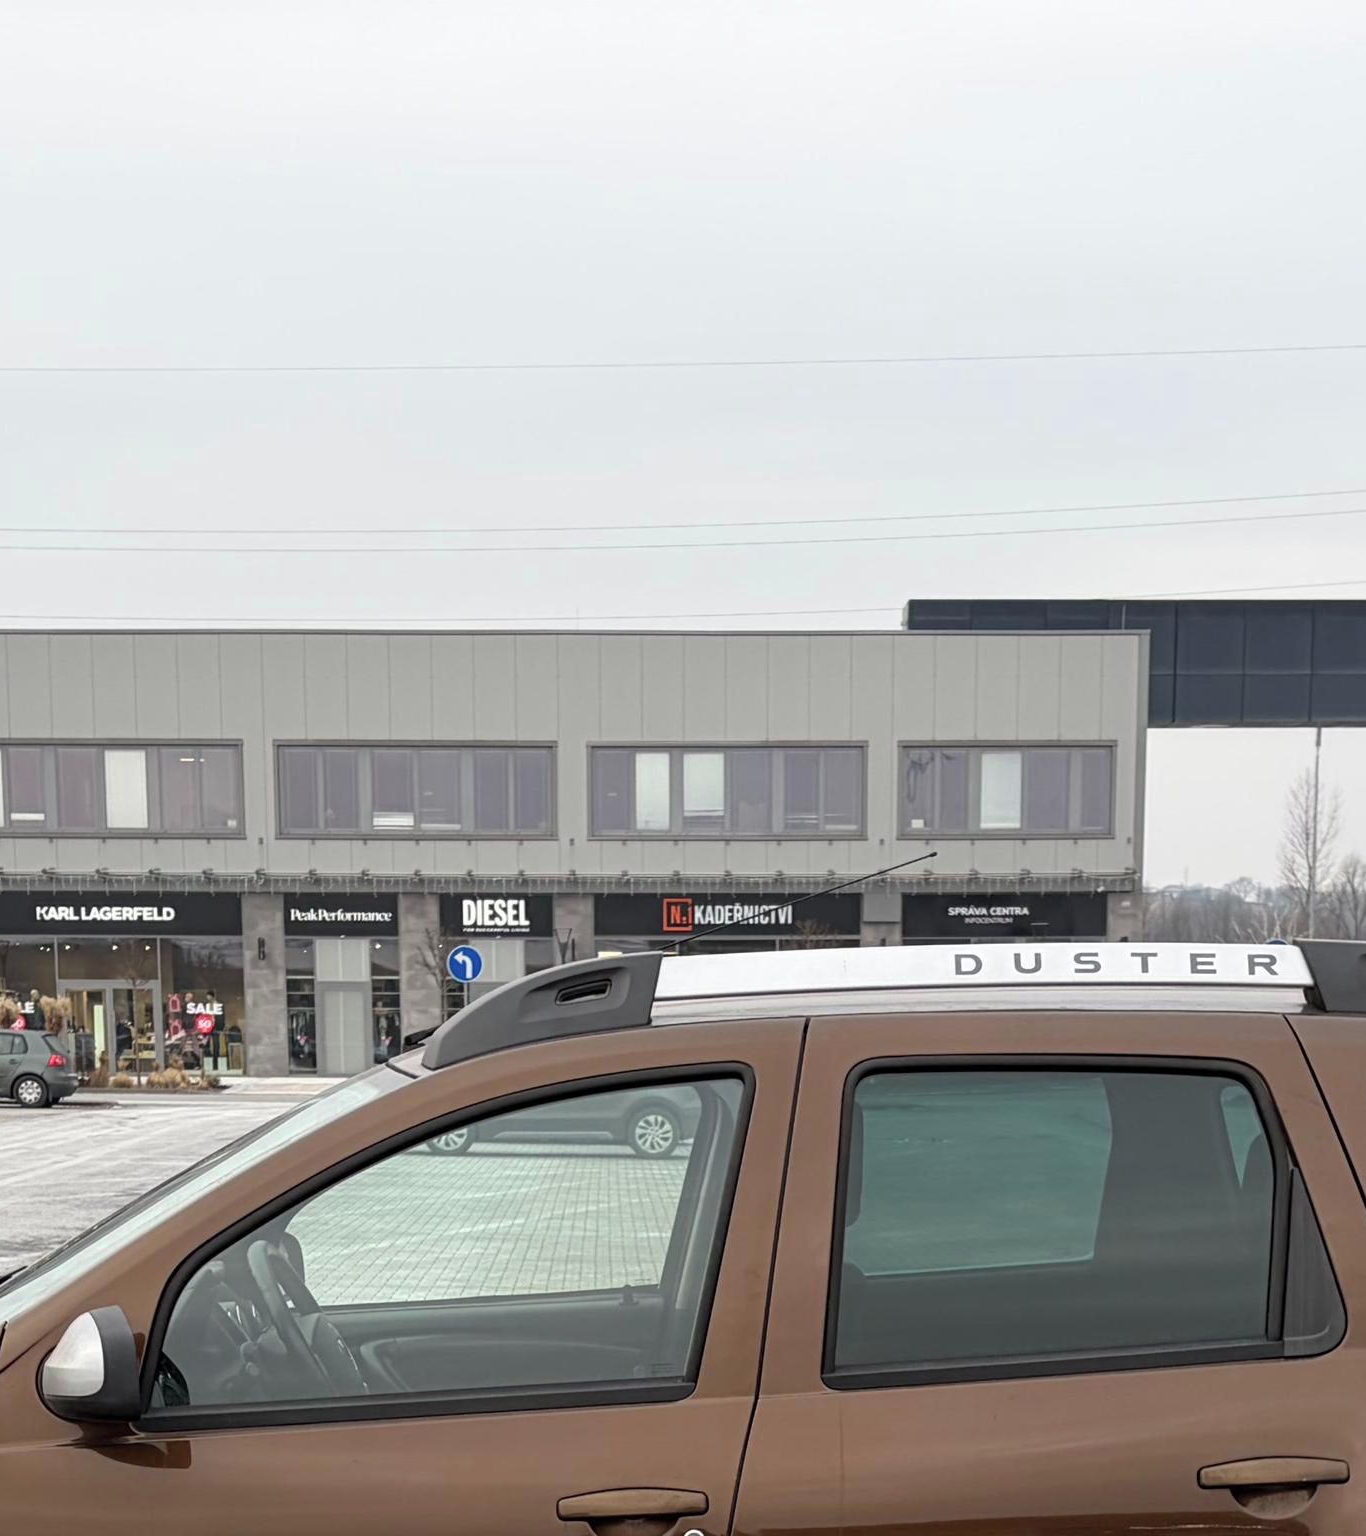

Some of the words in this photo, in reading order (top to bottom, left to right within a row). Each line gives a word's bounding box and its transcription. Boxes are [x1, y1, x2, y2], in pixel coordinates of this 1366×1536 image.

[35, 905, 79, 922] KARL
[81, 905, 175, 922] LAGERFELD
[462, 899, 530, 926] DIESEL
[947, 904, 988, 916] SPRÁVA
[989, 906, 1030, 916] CENTRA
[954, 952, 1279, 976] DUSTER
[186, 1002, 223, 1015] SALE
[197, 1019, 211, 1029] 50
